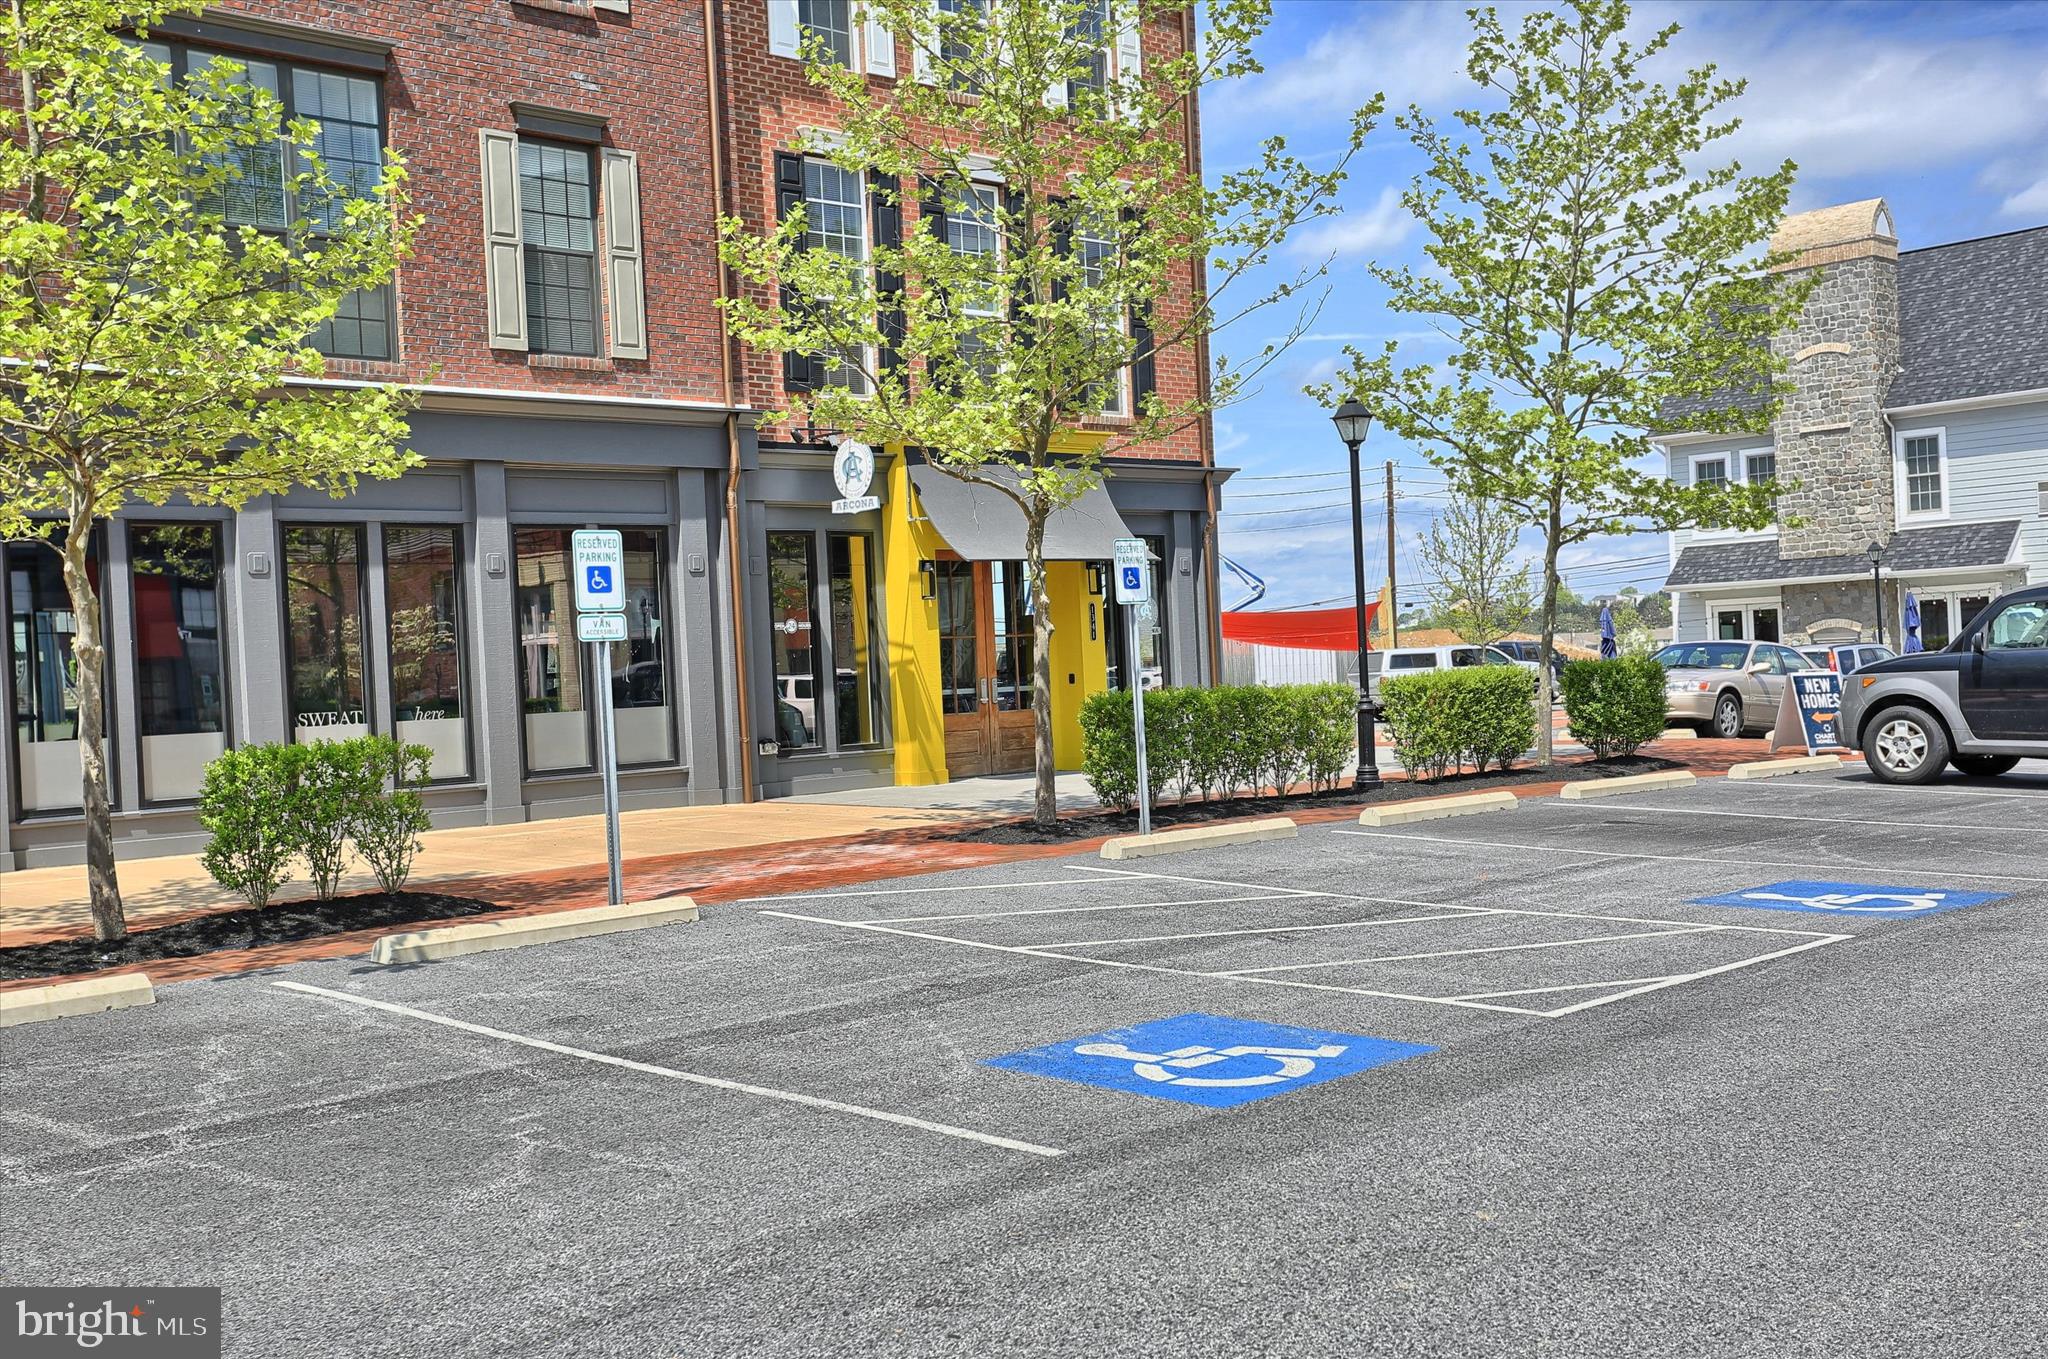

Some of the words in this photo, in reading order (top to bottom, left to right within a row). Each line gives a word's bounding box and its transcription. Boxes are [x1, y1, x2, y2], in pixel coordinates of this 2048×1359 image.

[836, 498, 874, 511] ARCONA
[577, 538, 617, 549] RESERVED
[1116, 545, 1144, 553] RESERVED
[579, 552, 617, 563] PARKING
[1117, 556, 1144, 564] PARKING
[593, 620, 611, 628] VAN
[1804, 678, 1830, 693] NEW
[1801, 693, 1840, 708] HOMES
[297, 710, 363, 727] SWEAT
[414, 706, 445, 720] here
